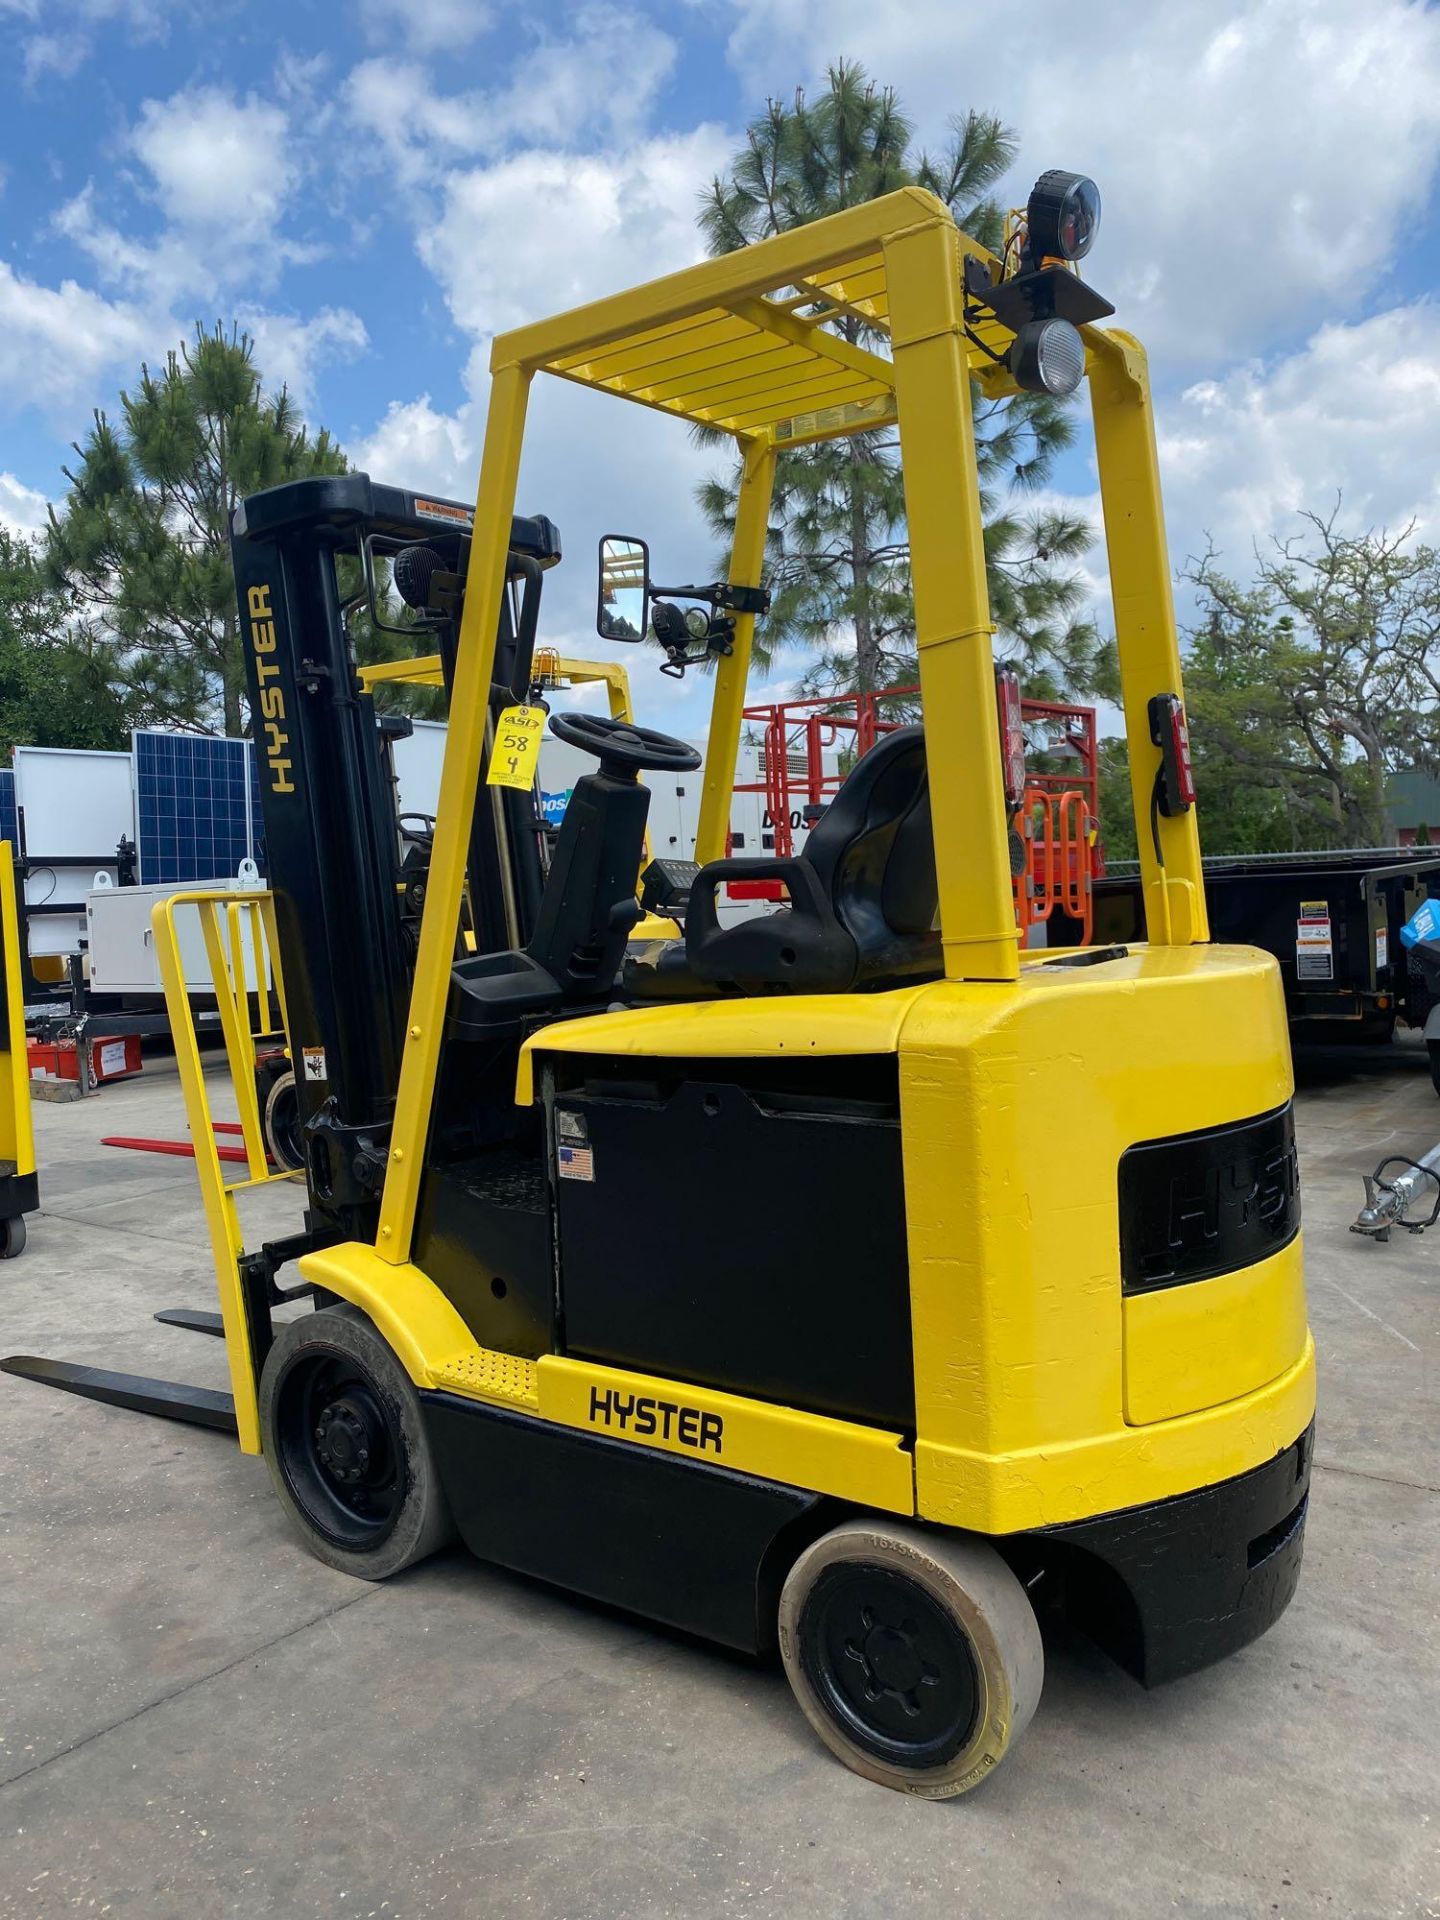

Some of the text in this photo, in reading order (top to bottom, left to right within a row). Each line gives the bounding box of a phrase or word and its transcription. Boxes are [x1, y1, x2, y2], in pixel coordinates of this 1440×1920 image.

[247, 584, 295, 793] HYSTER
[503, 735, 529, 752] 58
[507, 756, 519, 774] 4
[589, 1385, 724, 1454] HYSTER
